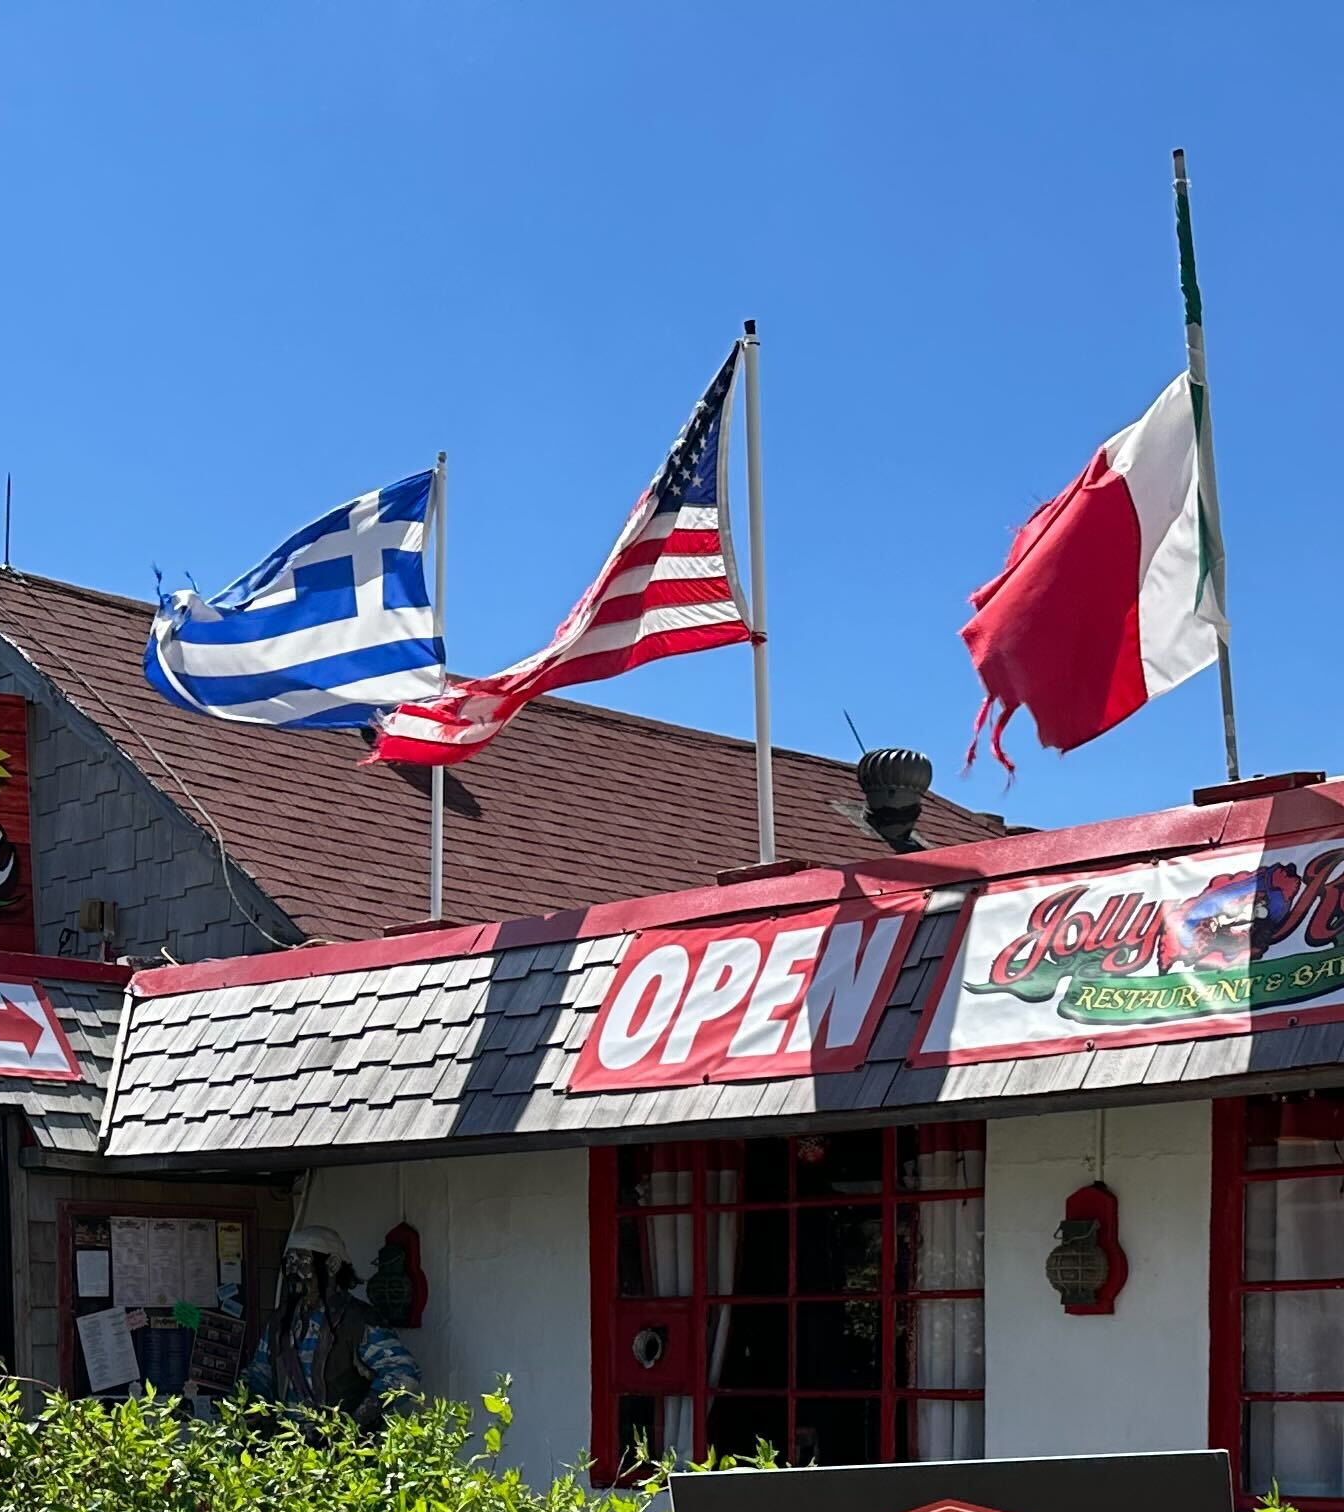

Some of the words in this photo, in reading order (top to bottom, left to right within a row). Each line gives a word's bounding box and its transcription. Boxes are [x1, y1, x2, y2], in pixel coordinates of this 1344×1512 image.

[989, 885, 1161, 983] Jolly
[598, 914, 905, 1071] OPEN
[1076, 978, 1256, 1011] RESTAURANT
[1264, 971, 1284, 993] &
